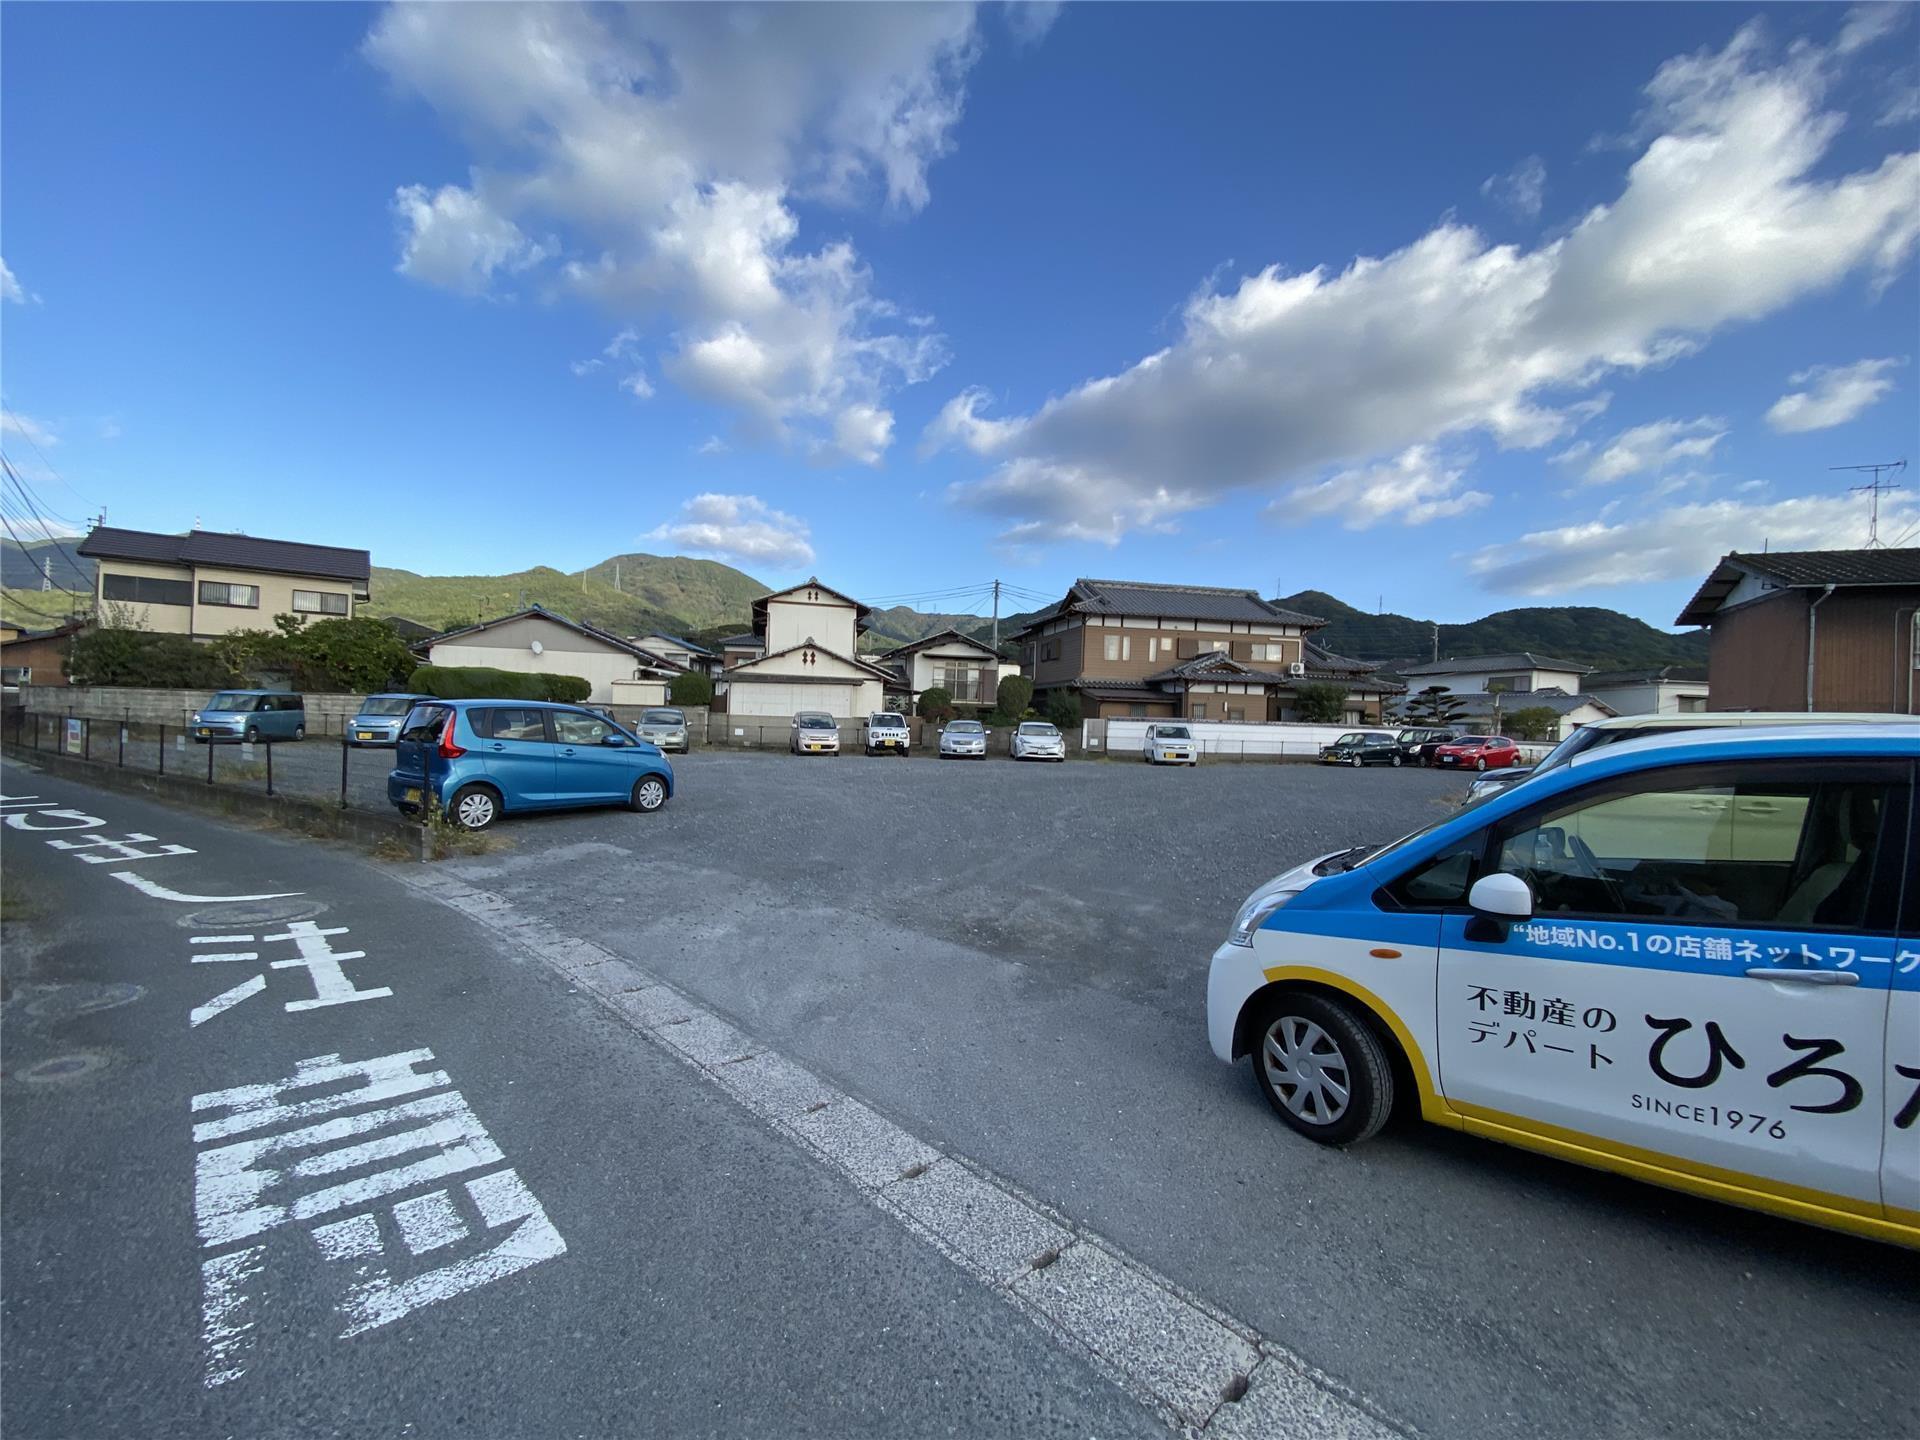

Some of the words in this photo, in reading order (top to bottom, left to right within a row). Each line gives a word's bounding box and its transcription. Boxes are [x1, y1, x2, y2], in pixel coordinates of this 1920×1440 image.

[1466, 984, 1617, 1033] 不動産の
[1467, 1020, 1614, 1069] デパート
